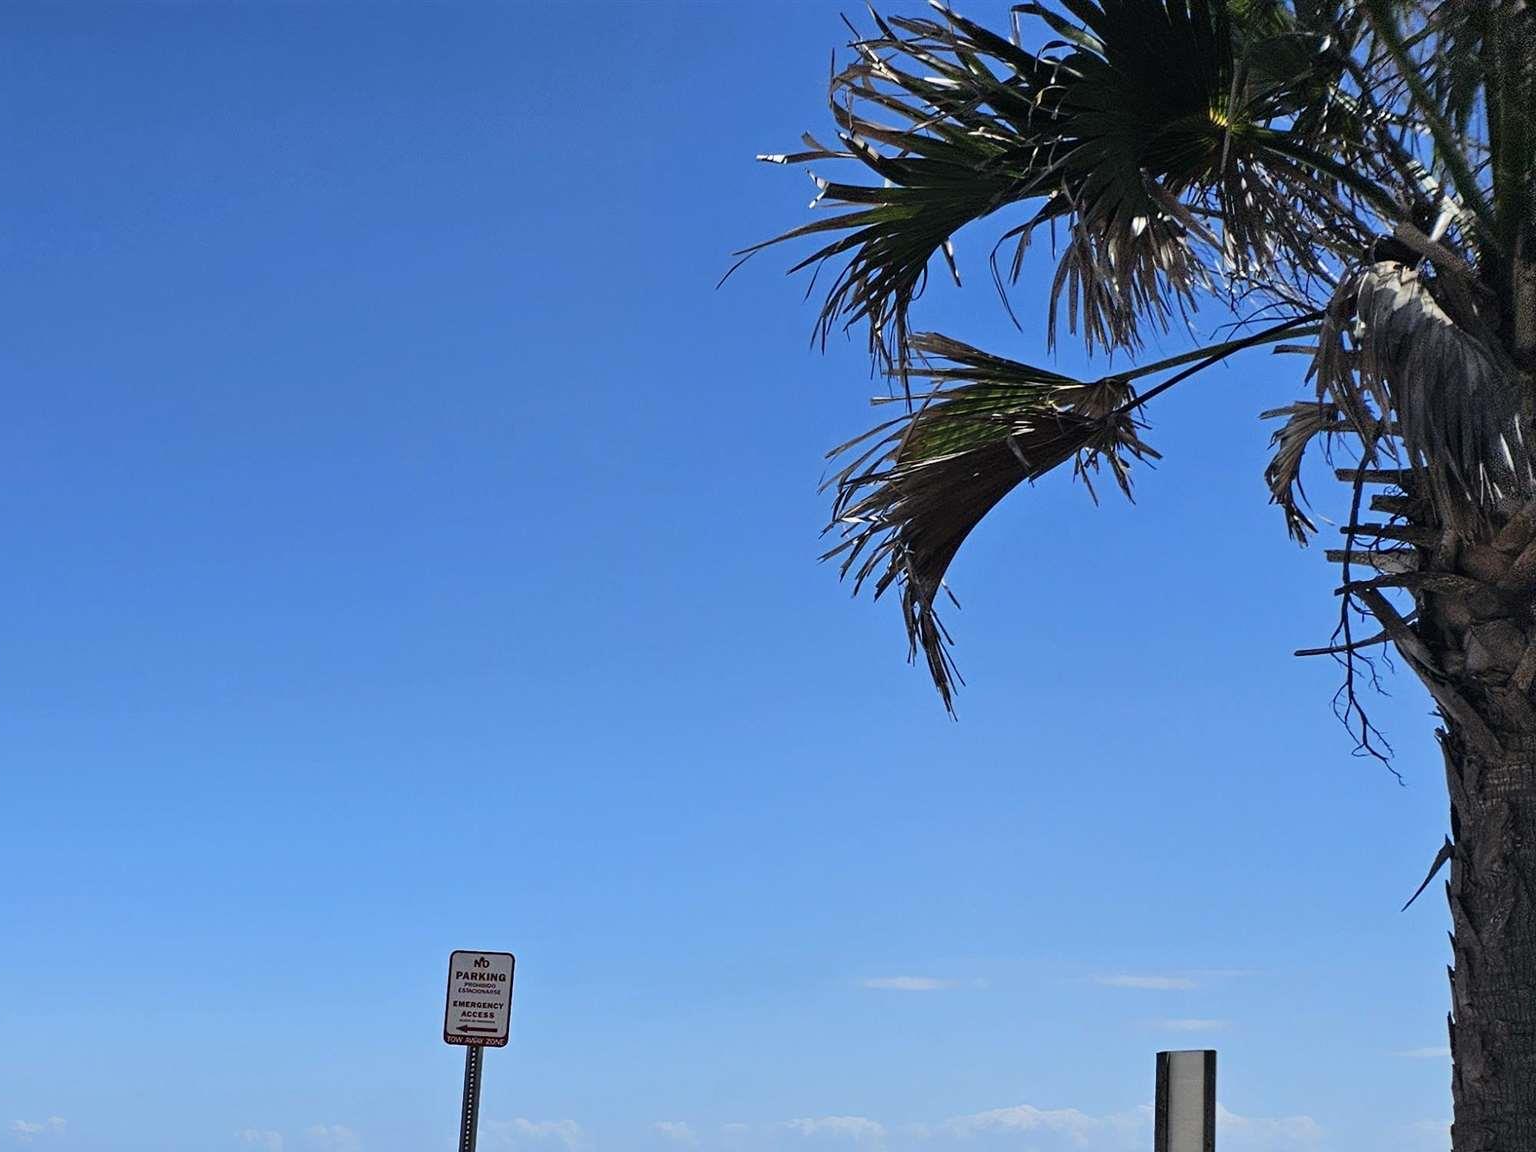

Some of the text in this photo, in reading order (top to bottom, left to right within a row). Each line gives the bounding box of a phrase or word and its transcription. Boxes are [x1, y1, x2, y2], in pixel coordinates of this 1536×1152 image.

[474, 960, 490, 968] NO
[455, 971, 506, 982] PARKING
[453, 1001, 504, 1010] EMERGENCY
[461, 1011, 495, 1019] ACCESS
